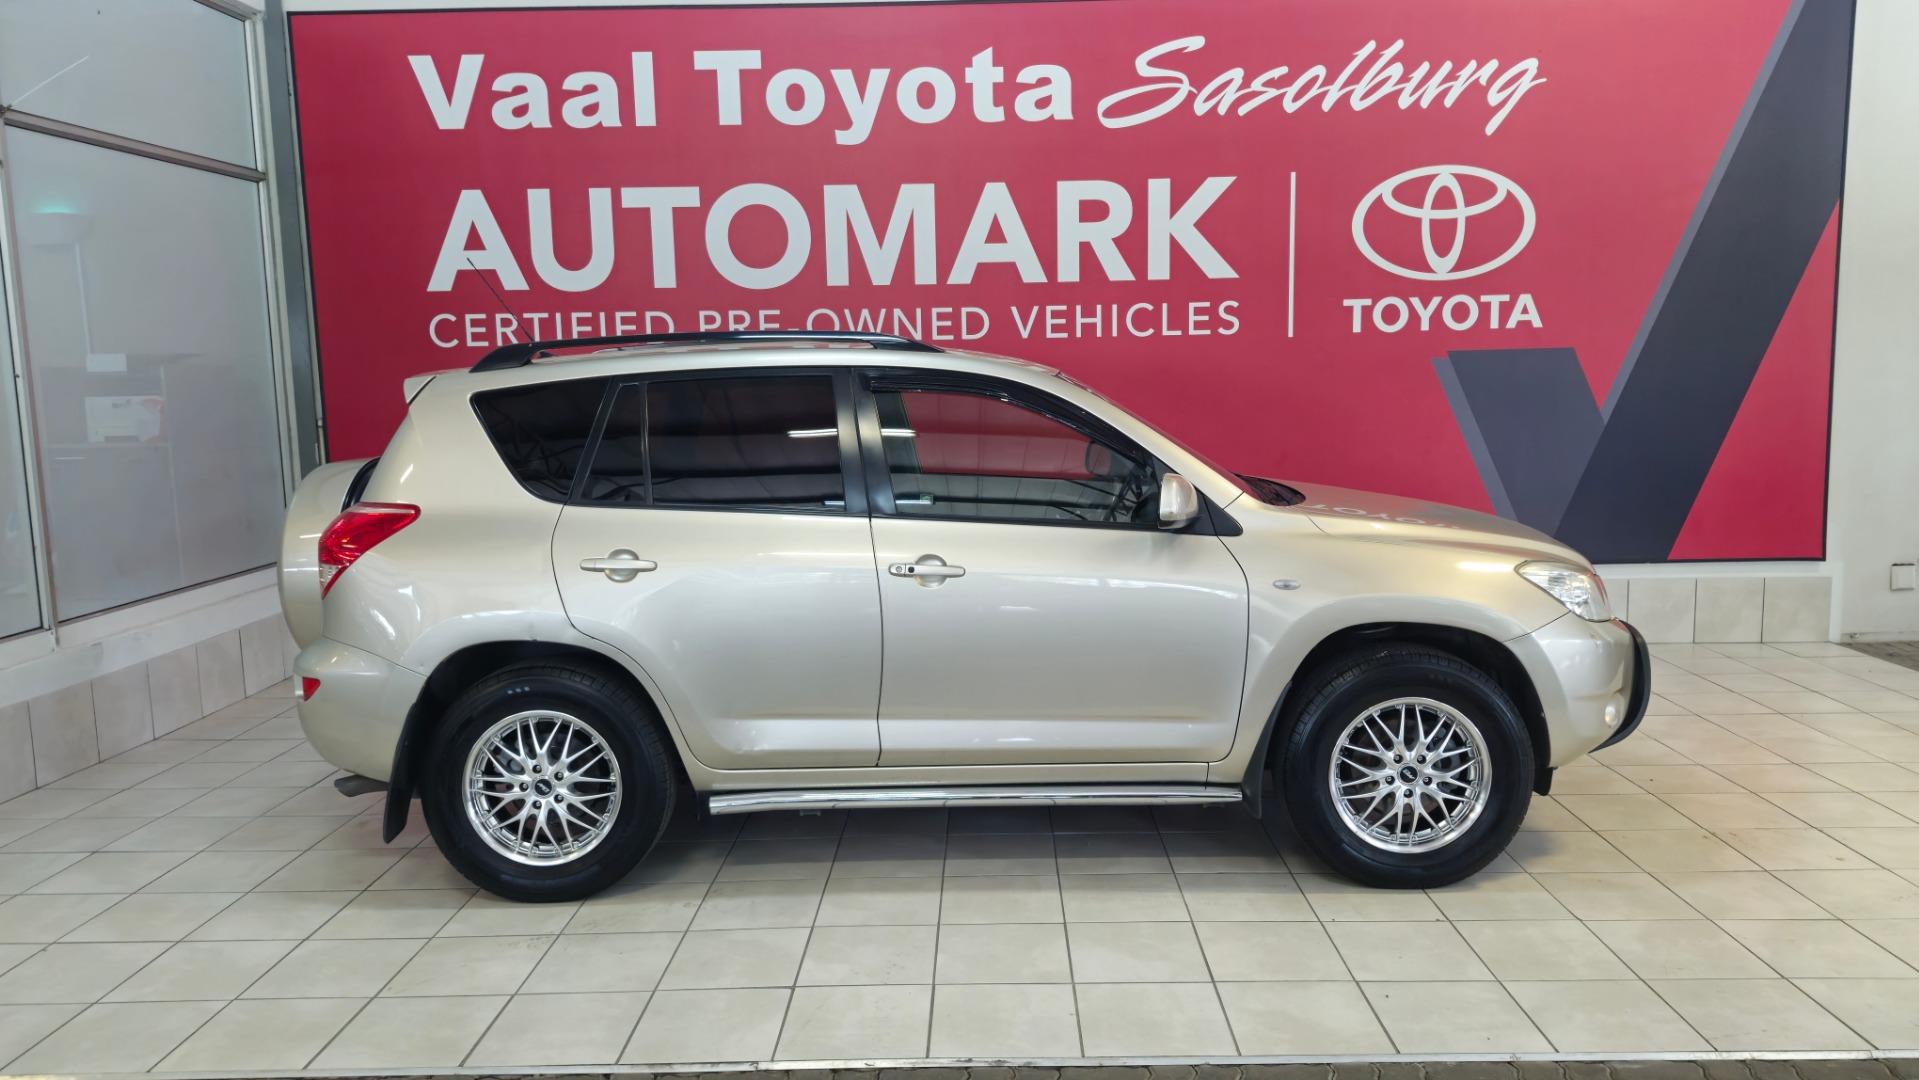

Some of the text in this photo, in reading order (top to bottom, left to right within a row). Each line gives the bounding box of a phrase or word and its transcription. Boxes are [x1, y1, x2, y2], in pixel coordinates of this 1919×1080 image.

[407, 35, 1548, 146] Vaal Toyota Sasolburg
[426, 175, 1240, 292] AUTOMARK
[429, 311, 675, 348] CERTIFIED
[1010, 300, 1240, 339] VEHICLES
[1342, 293, 1543, 333] TOYOTA
